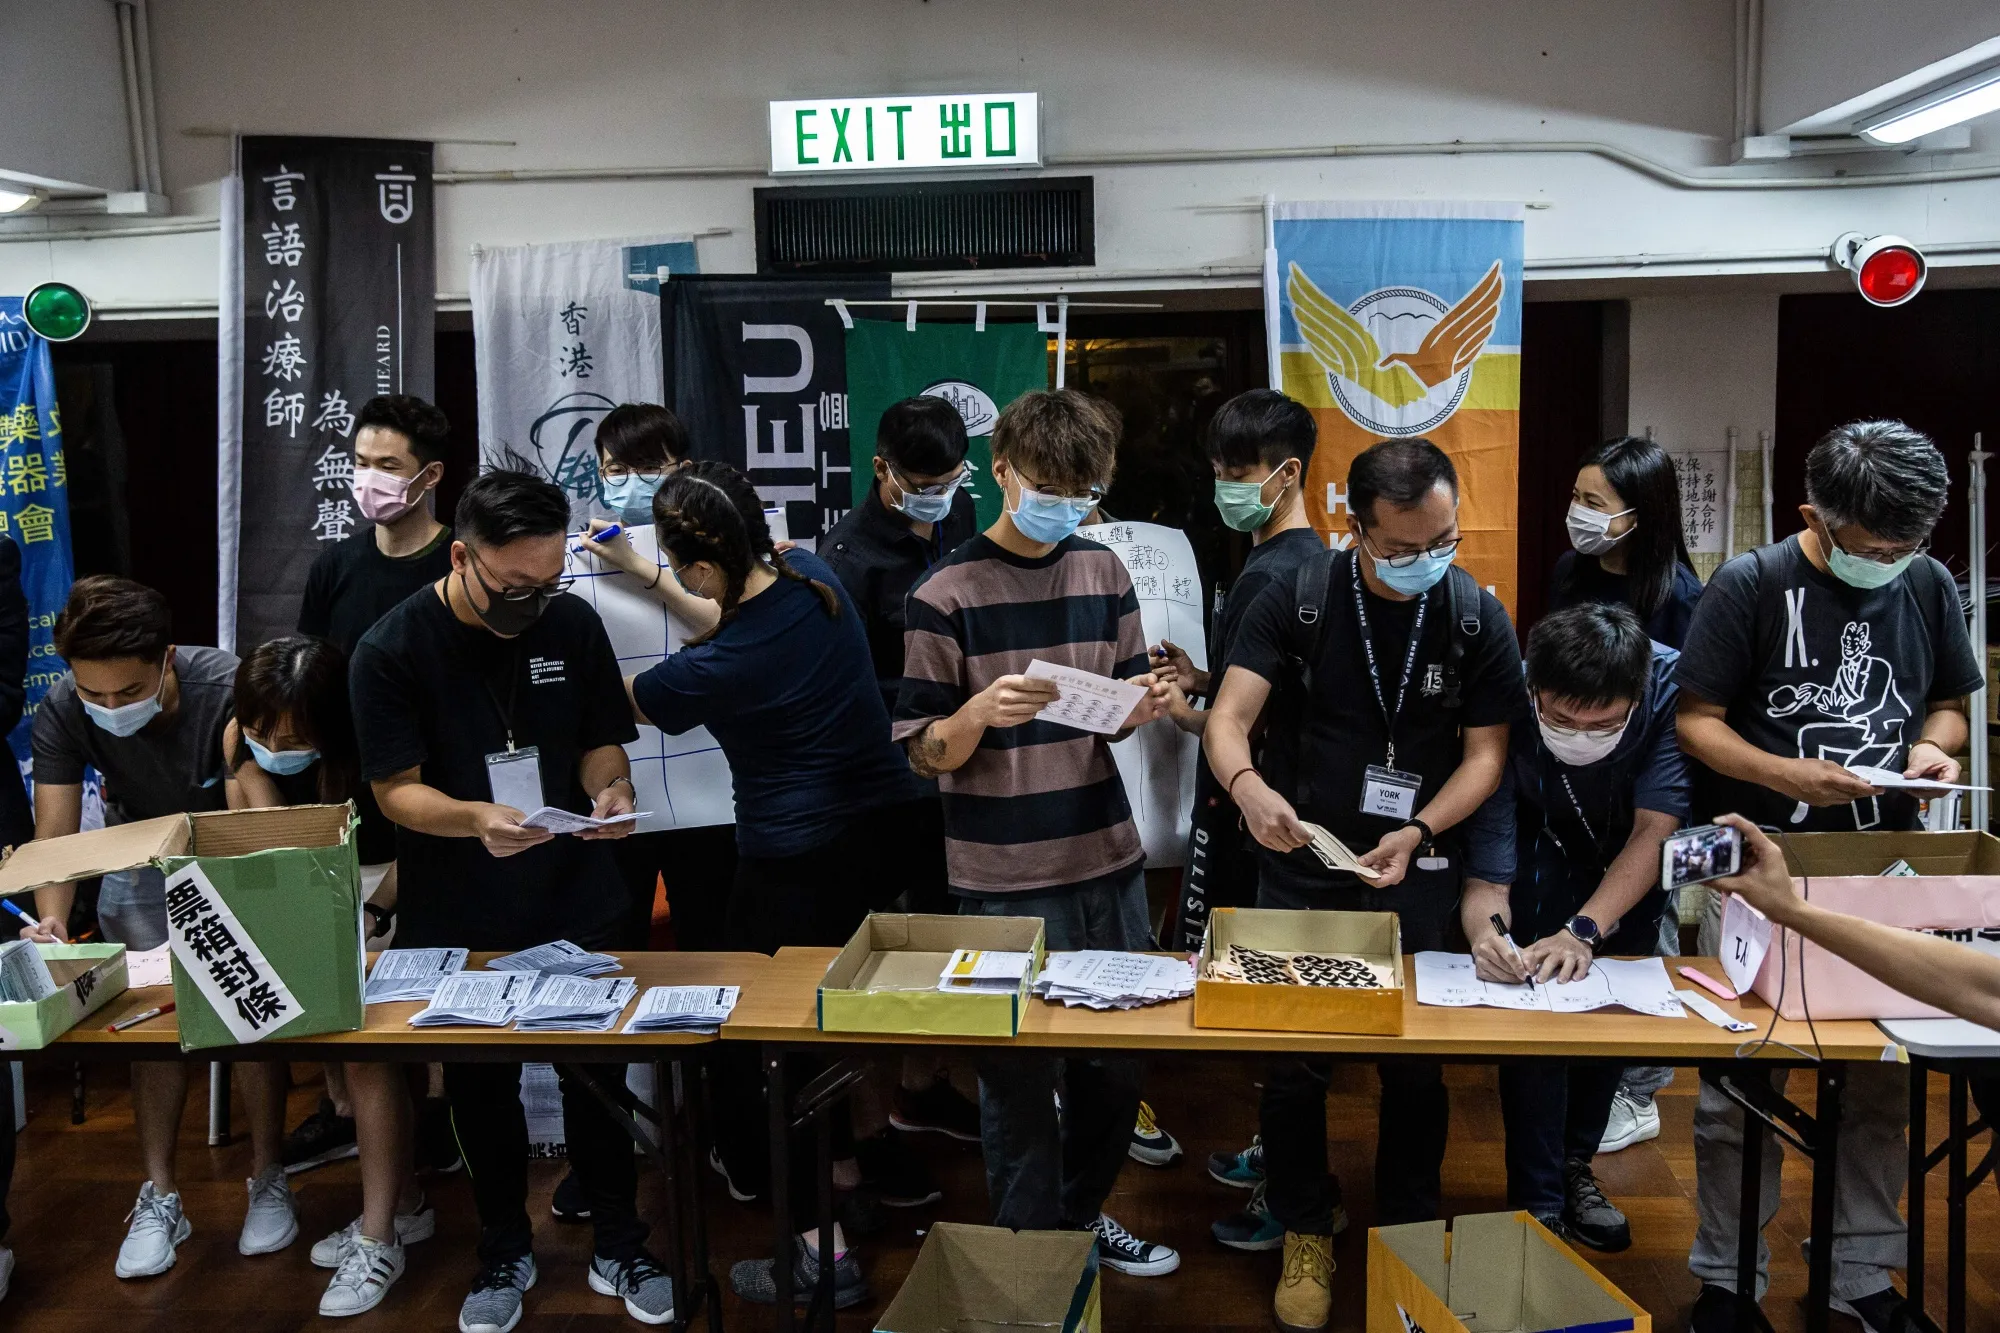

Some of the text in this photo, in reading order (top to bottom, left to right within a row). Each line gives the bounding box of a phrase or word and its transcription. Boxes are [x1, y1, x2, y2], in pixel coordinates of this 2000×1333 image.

[795, 101, 1017, 164] EXIT 出口
[262, 163, 308, 439] 言語治療師
[559, 301, 594, 379] 香港
[377, 325, 391, 396] HEARD
[311, 389, 356, 542] 為無聲
[1701, 472, 1717, 534] 多謝合作
[1379, 788, 1401, 800] YORK
[1184, 827, 1210, 953] OLLISTE
[166, 877, 288, 1031] 票箱封條
